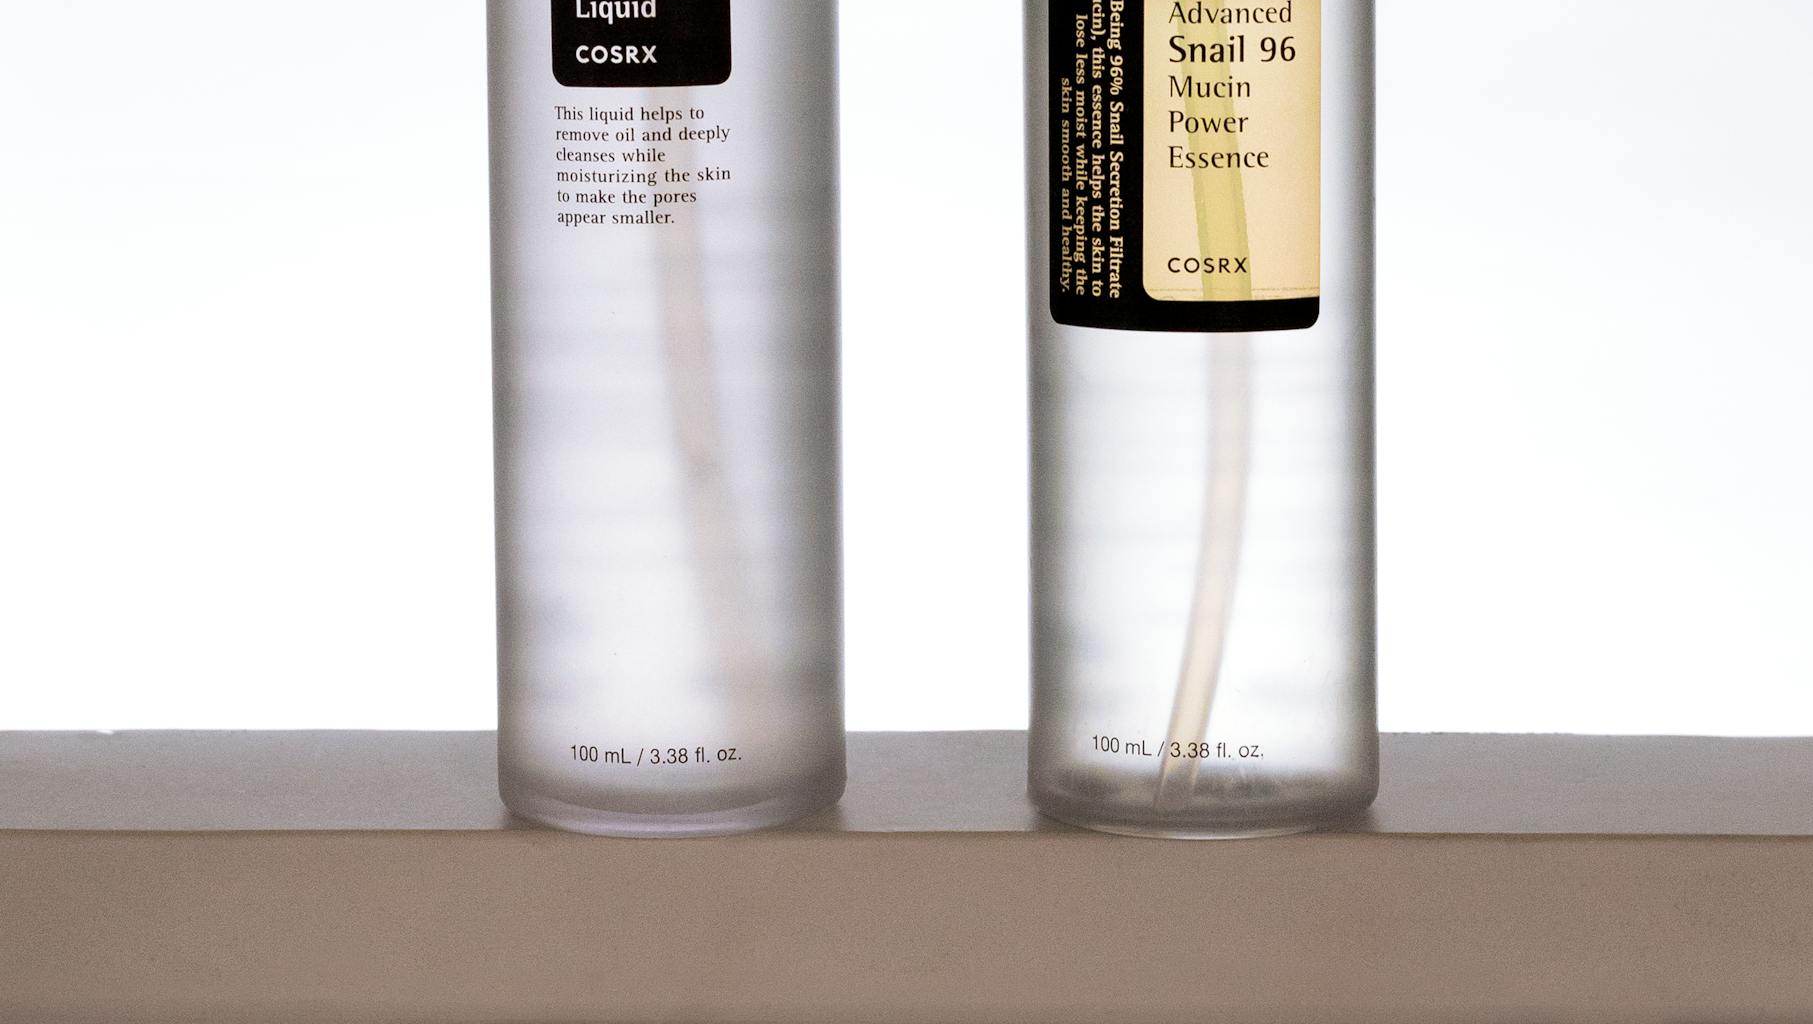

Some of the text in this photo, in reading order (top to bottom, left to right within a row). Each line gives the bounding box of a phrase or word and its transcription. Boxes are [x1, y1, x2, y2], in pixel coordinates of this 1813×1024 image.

[1168, 0, 1291, 23] Advanced
[576, 45, 657, 63] COSRX
[1169, 35, 1296, 63] Snail 96
[1092, 47, 1105, 79] this
[1168, 75, 1250, 97] Mucin
[554, 105, 704, 124] This liquid helps to
[1092, 85, 1102, 149] essence
[1168, 111, 1249, 133] Power
[556, 125, 730, 143] remove oil and deeply
[556, 147, 666, 162] cleanses while
[1073, 14, 1088, 295] lose less moist while keeping the
[1107, 0, 1124, 298] Being 96% Snail Secretion Filtrate
[1168, 146, 1269, 168] Essence
[557, 167, 731, 186] moisturizing the skin
[1060, 78, 1073, 292] skin smooth and healthy.
[1089, 153, 1105, 199] helps
[557, 190, 696, 207] to make the pores
[557, 210, 675, 227] appear smaller.
[1092, 205, 1105, 232] the
[1092, 237, 1105, 274] skin
[1168, 258, 1247, 273] COSRX
[1092, 279, 1104, 297] to
[571, 745, 741, 766] 100 mL / 3.38 fl. oz.
[1092, 735, 1264, 758] 100 mL / 3.38 fl. oz.
